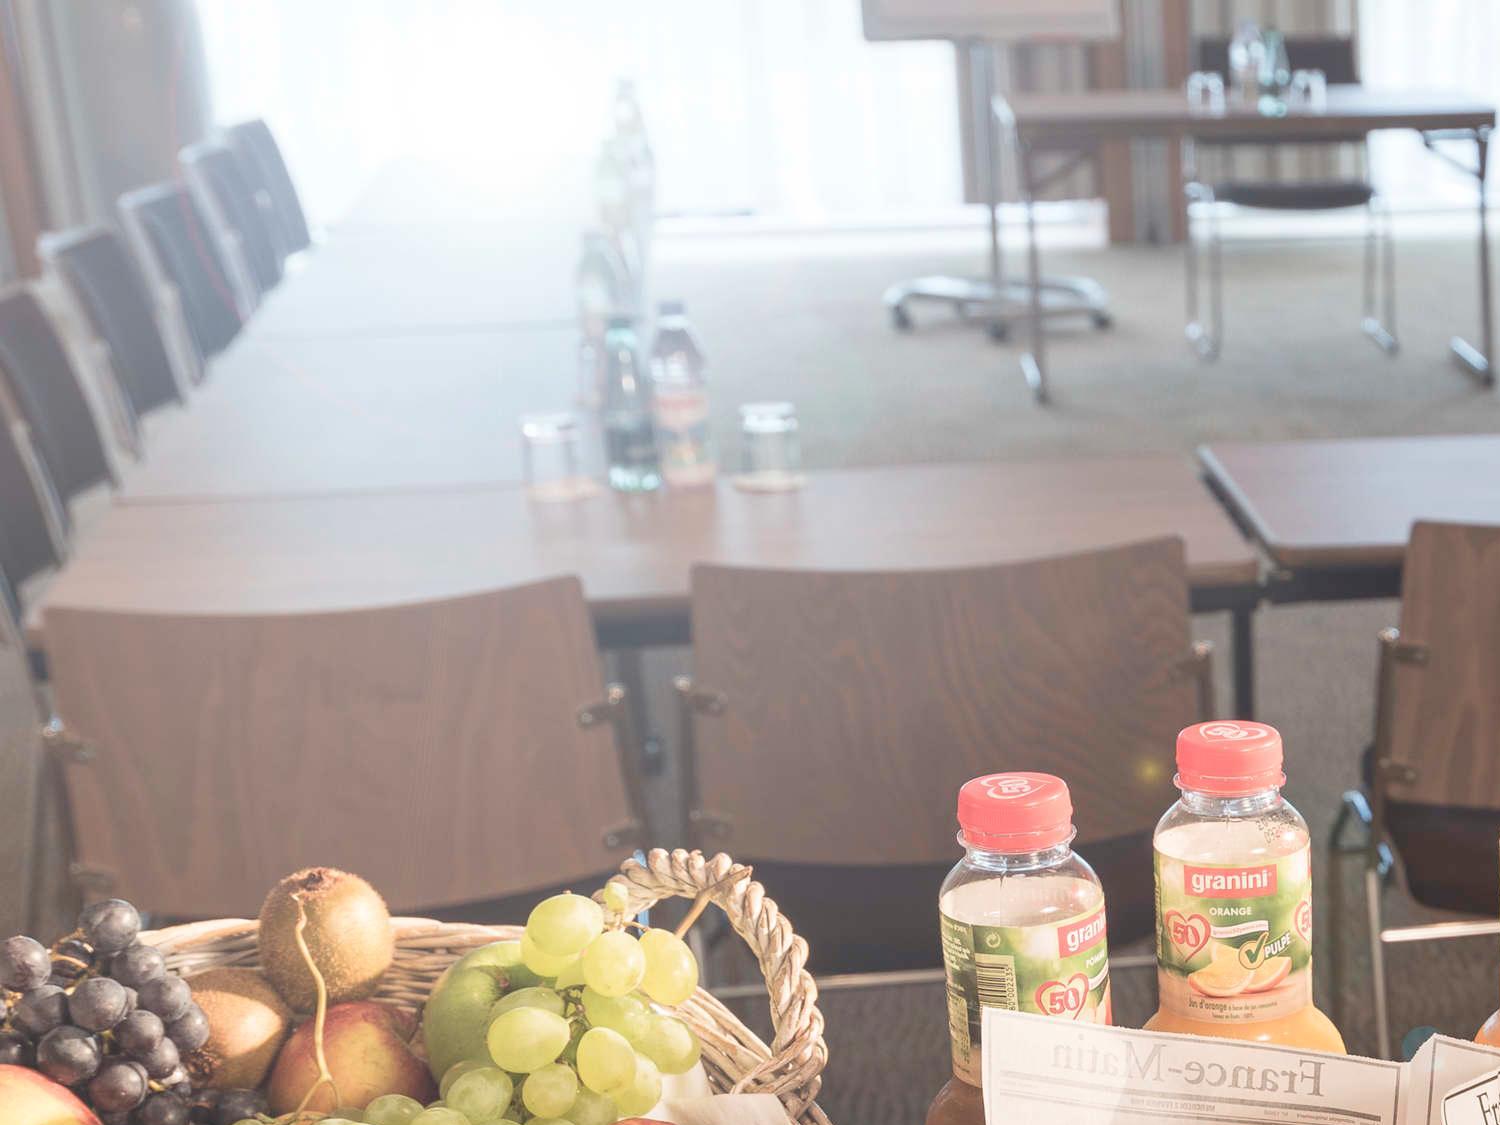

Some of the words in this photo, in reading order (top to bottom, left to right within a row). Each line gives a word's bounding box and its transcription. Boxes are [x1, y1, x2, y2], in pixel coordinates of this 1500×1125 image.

[1192, 869, 1268, 893] granini
[1209, 906, 1252, 917] ORANGE
[1173, 922, 1200, 948] 50
[1264, 932, 1292, 958] PULPE
[1049, 987, 1080, 1015] 50
